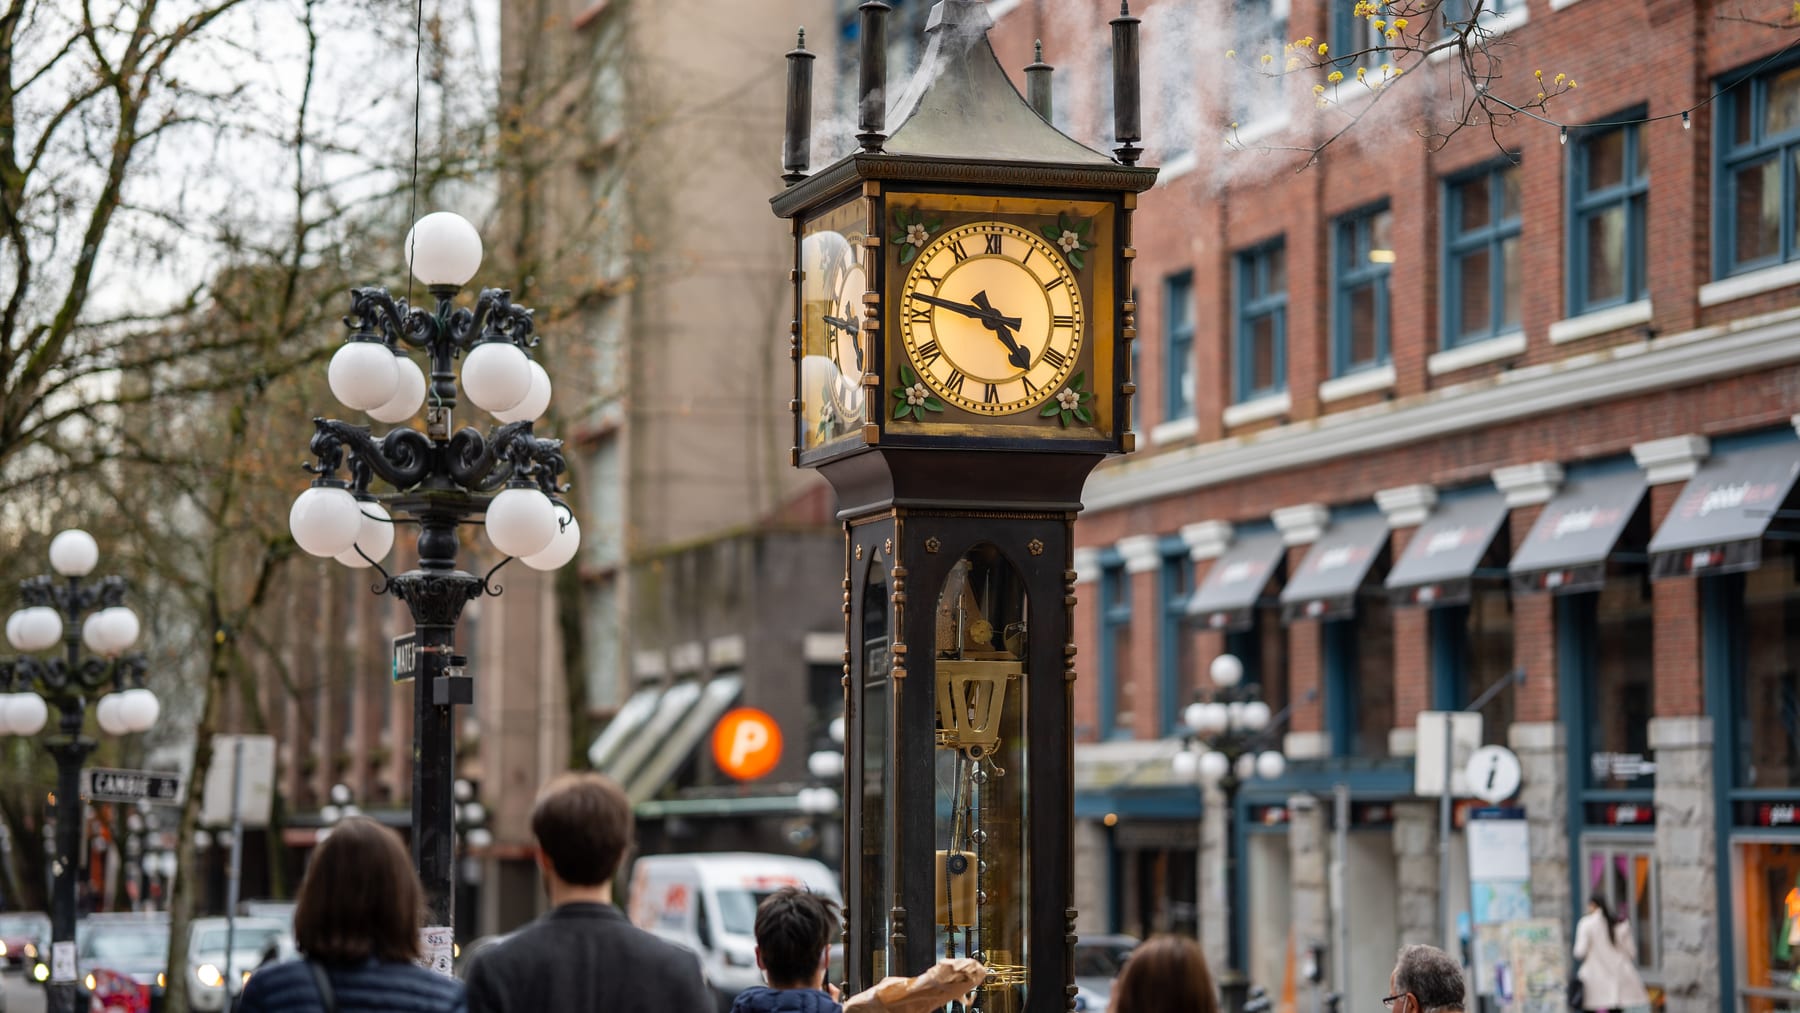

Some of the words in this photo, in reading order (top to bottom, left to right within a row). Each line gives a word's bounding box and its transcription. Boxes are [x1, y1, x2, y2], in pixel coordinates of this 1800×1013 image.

[948, 240, 968, 264] XI
[985, 234, 1002, 254] XII
[1023, 246, 1035, 264] I
[920, 269, 942, 288] X
[1045, 276, 1063, 291] II
[911, 308, 931, 323] IX
[1054, 315, 1074, 328] III
[917, 340, 941, 367] VIII
[1042, 347, 1066, 369] IIII
[945, 368, 965, 395] VII
[1022, 376, 1038, 396] V
[984, 383, 1000, 404] VI
[729, 719, 769, 768] P
